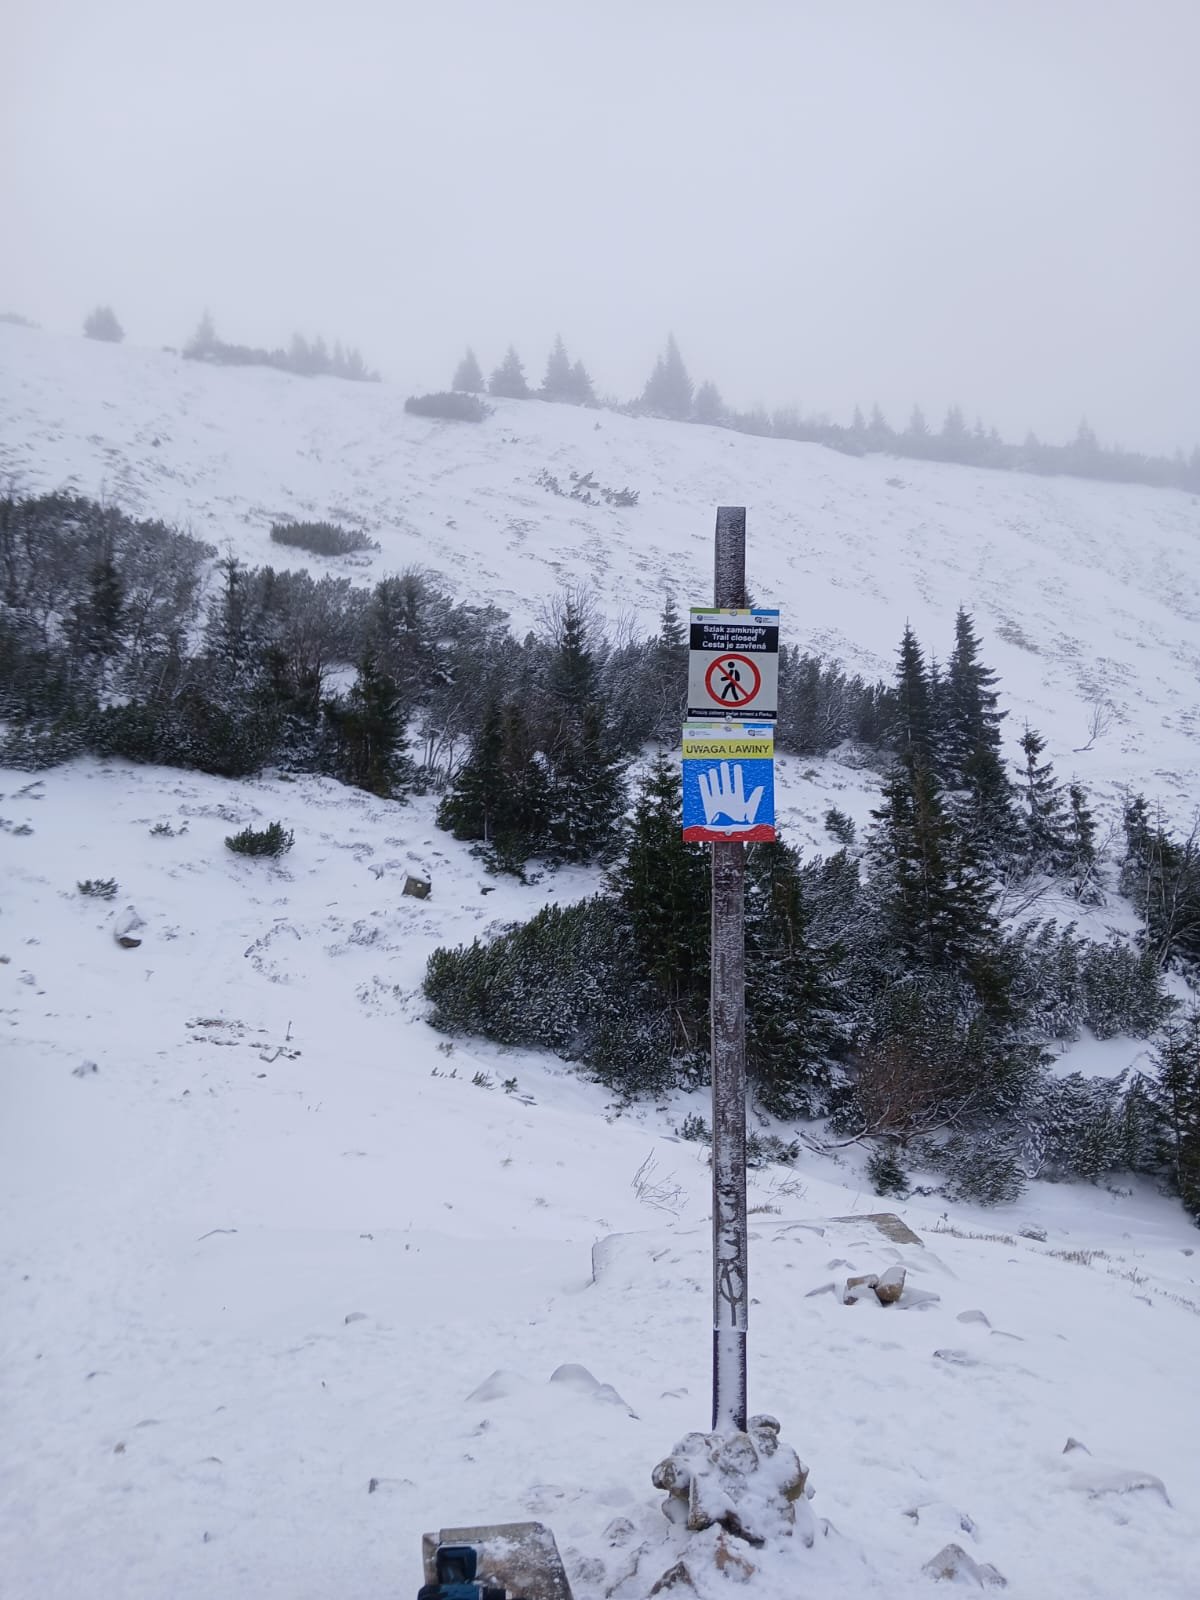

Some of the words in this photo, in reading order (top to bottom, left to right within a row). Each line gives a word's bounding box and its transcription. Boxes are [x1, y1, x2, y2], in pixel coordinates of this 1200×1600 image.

[726, 642, 734, 650] je
[686, 744, 726, 754] UWAGA
[729, 744, 770, 754] LAWINY
